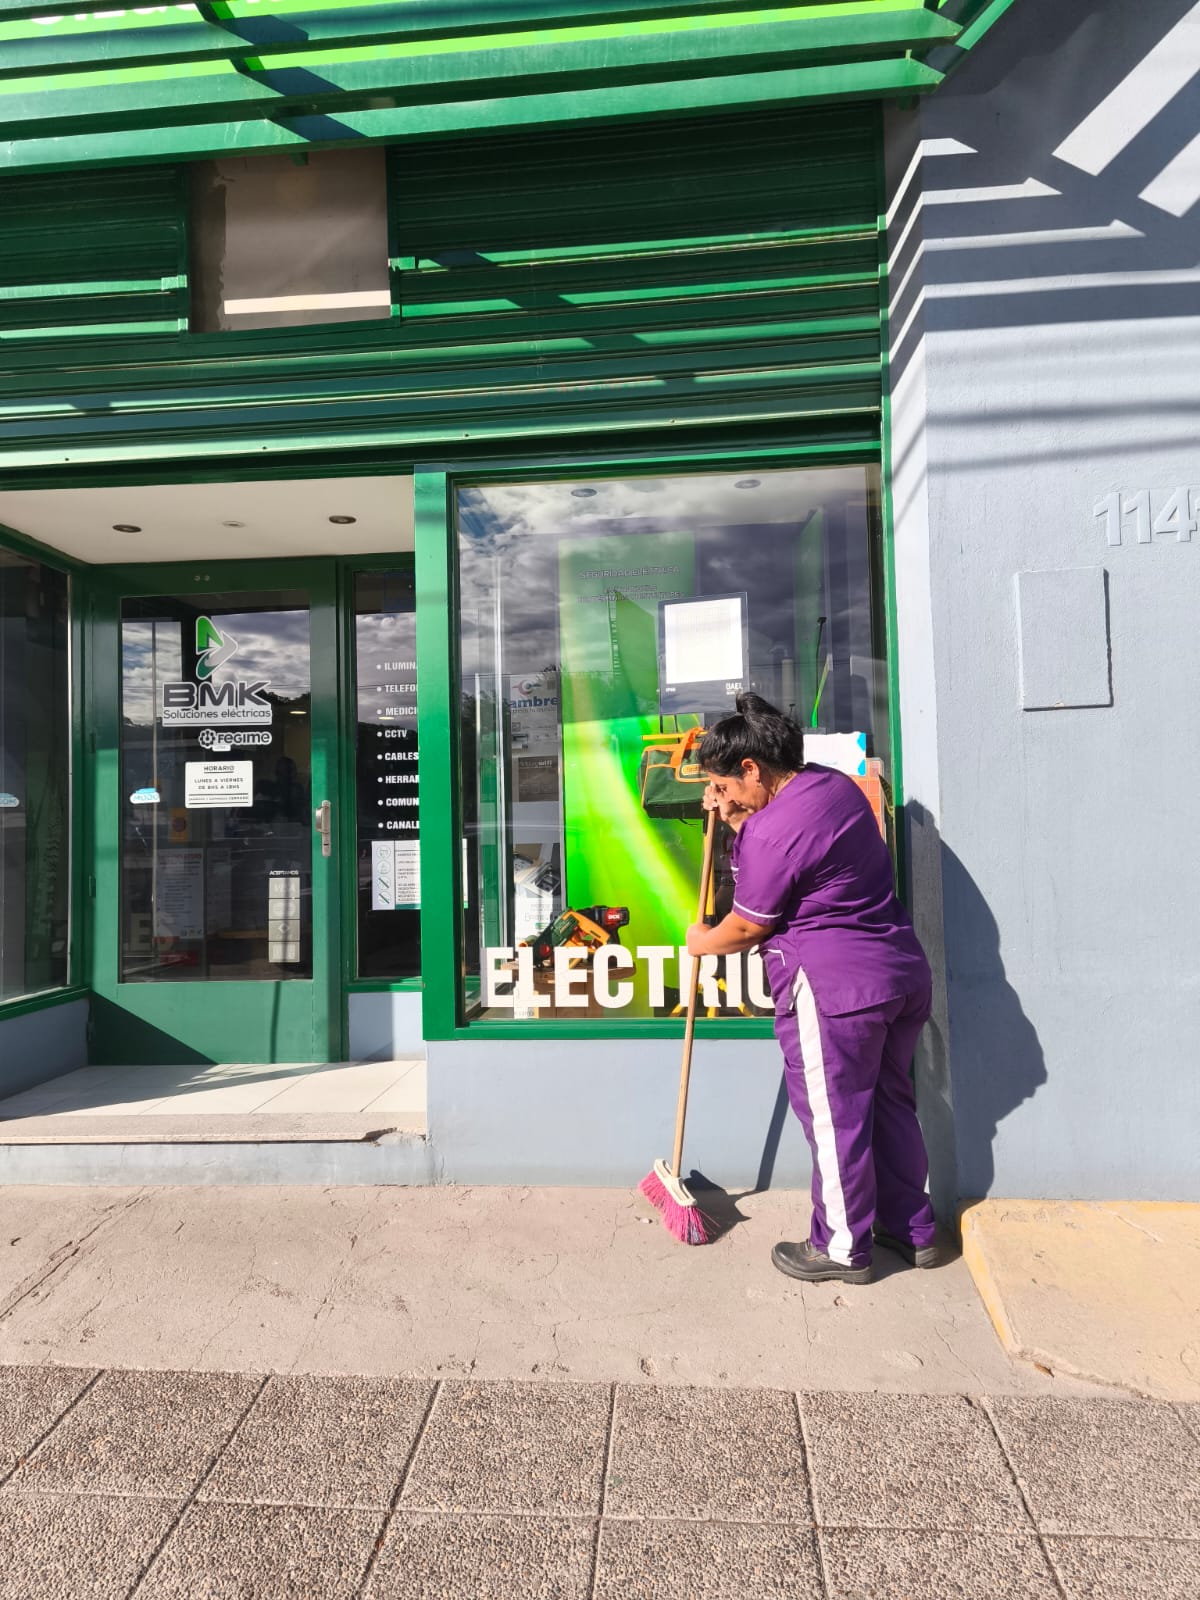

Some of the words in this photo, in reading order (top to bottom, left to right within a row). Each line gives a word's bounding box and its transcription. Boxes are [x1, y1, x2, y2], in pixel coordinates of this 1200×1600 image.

[1093, 486, 1200, 547] 114
[384, 662, 417, 671] ILUMIN
[385, 684, 417, 693] TELEFO
[163, 682, 271, 708] BMK
[508, 695, 560, 708] ambre
[163, 709, 218, 719] Soluciones
[221, 708, 271, 718] eléctricas
[384, 729, 408, 738] CCTV
[384, 752, 419, 761] CABLES
[385, 797, 420, 807] COMUN
